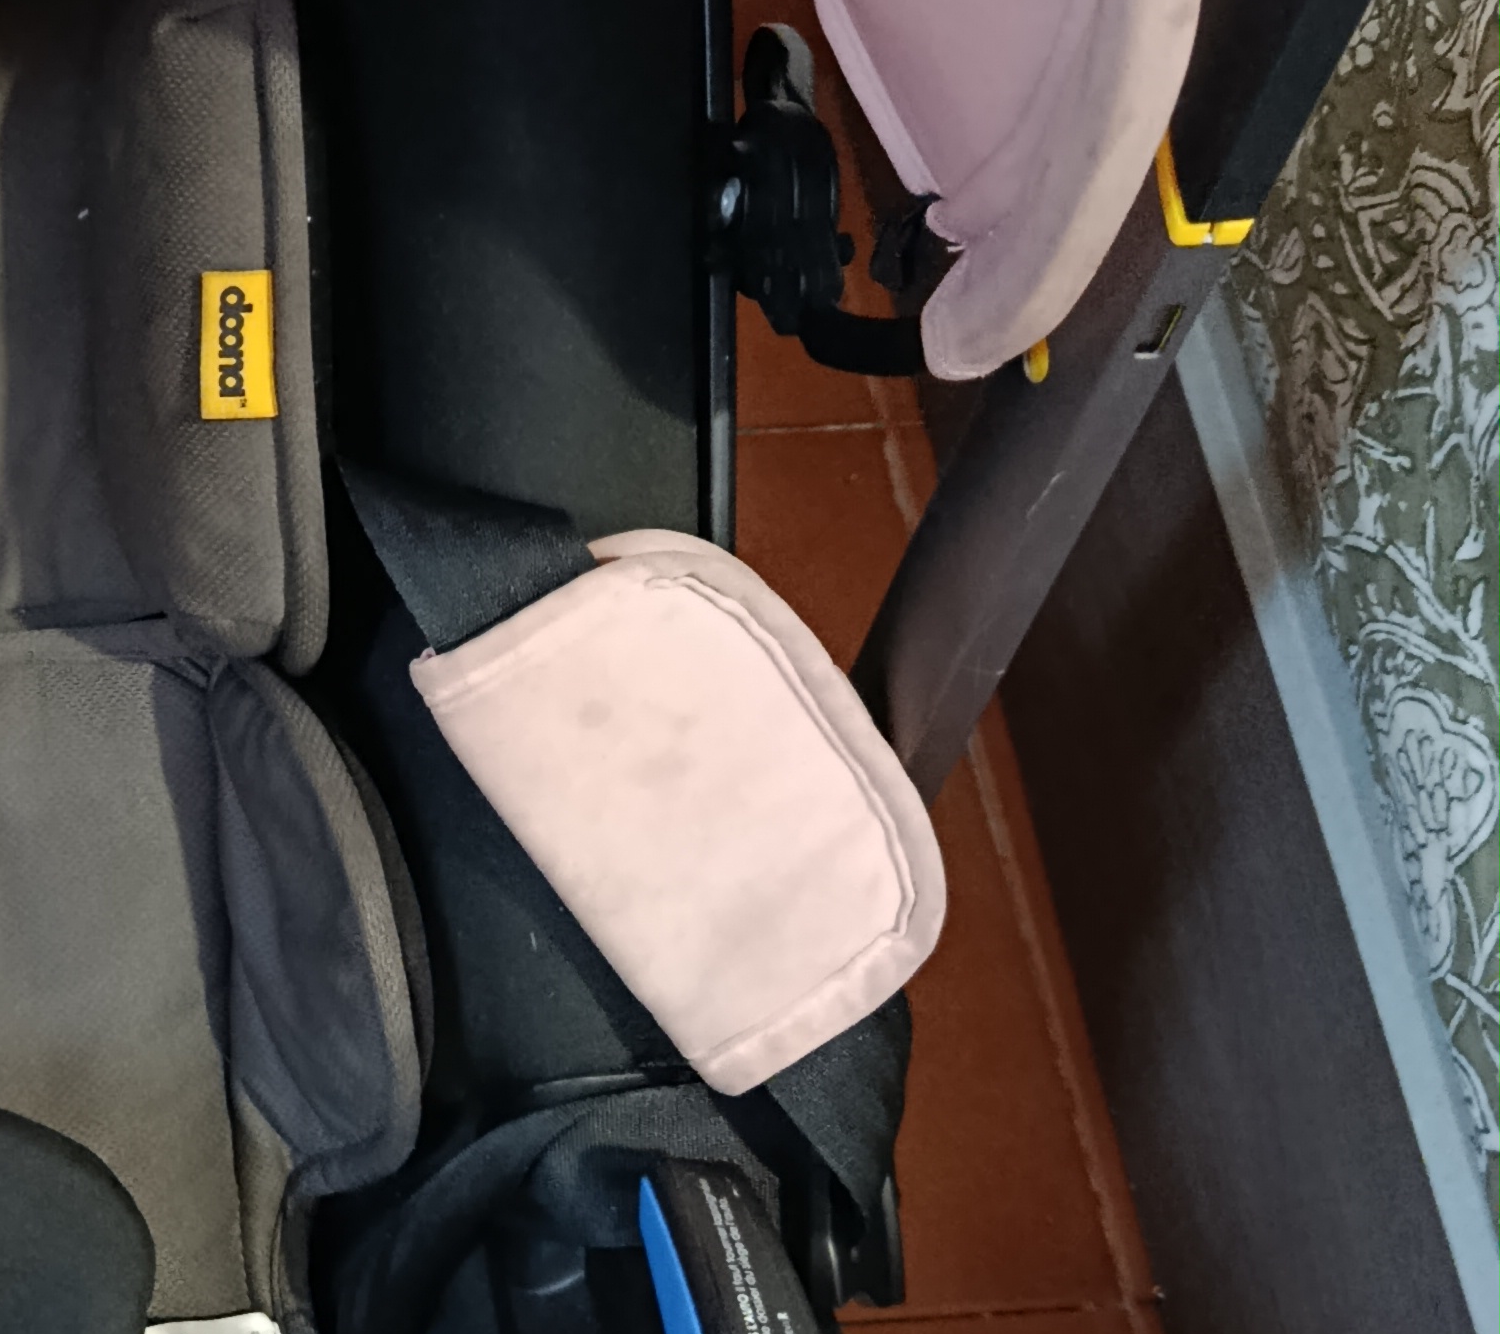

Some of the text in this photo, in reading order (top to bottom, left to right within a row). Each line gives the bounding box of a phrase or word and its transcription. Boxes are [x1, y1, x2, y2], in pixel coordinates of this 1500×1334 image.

[218, 285, 253, 398] doona
[743, 1270, 756, 1286] du
[749, 1287, 769, 1324] dossier
